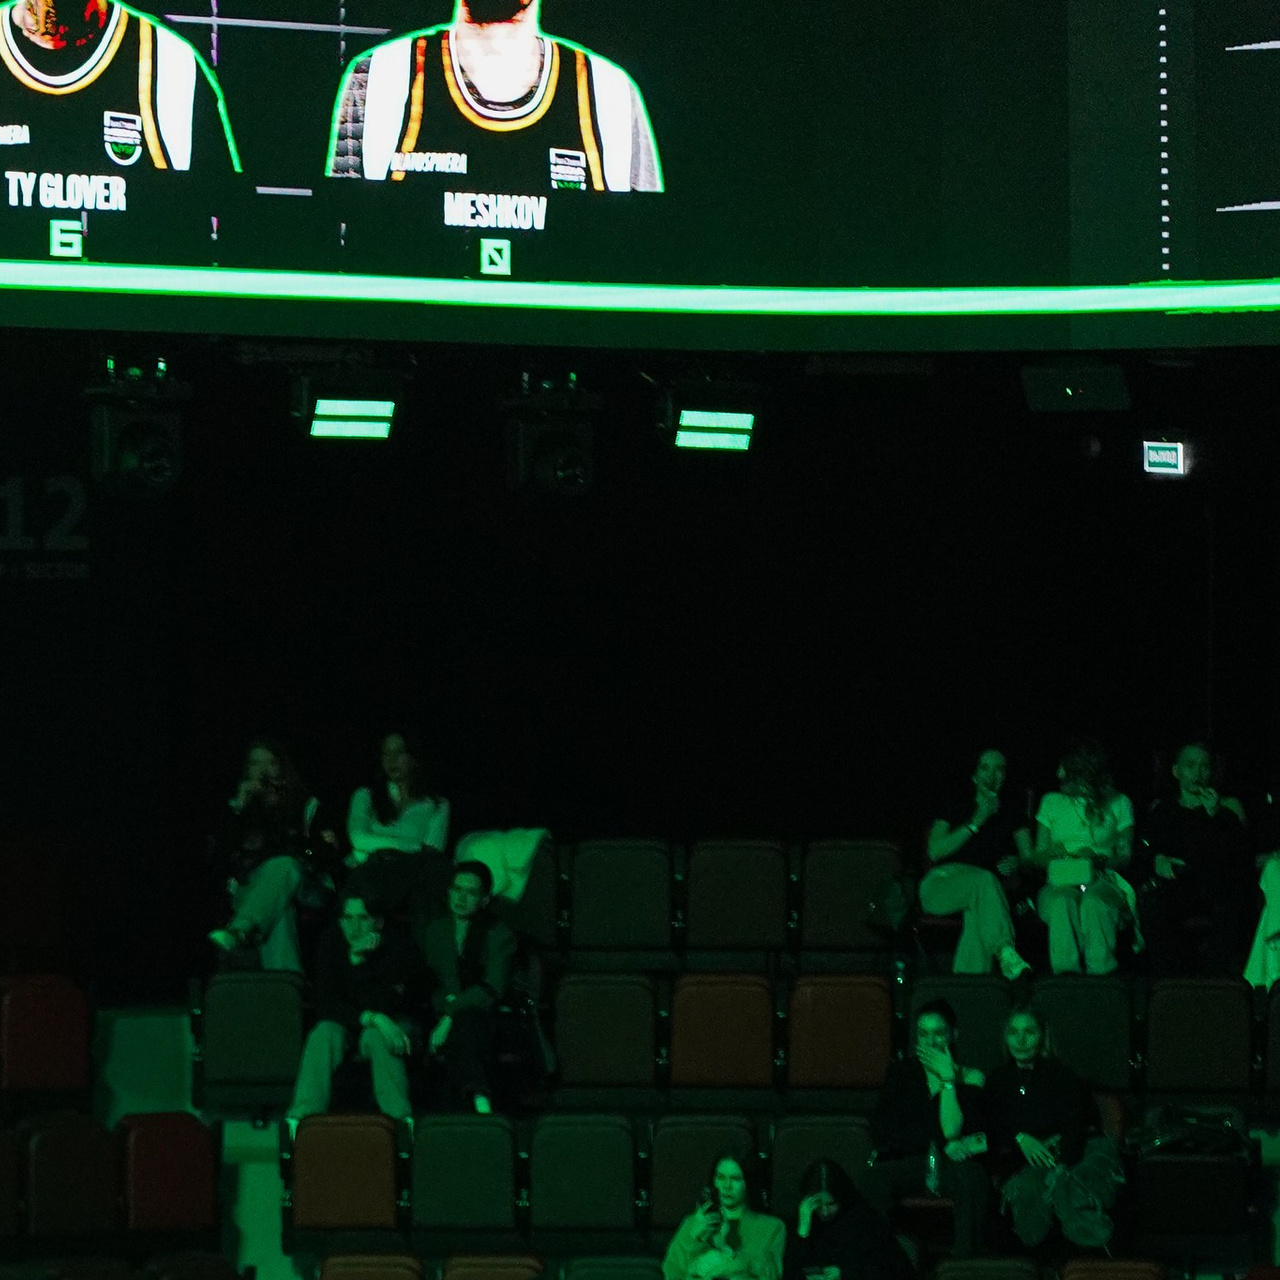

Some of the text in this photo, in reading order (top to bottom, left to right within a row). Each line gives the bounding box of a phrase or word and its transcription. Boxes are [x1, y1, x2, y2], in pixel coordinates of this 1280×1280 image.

[5, 171, 126, 210] TY GLOVER
[444, 191, 547, 230] MESHKOV
[50, 219, 83, 257] 6
